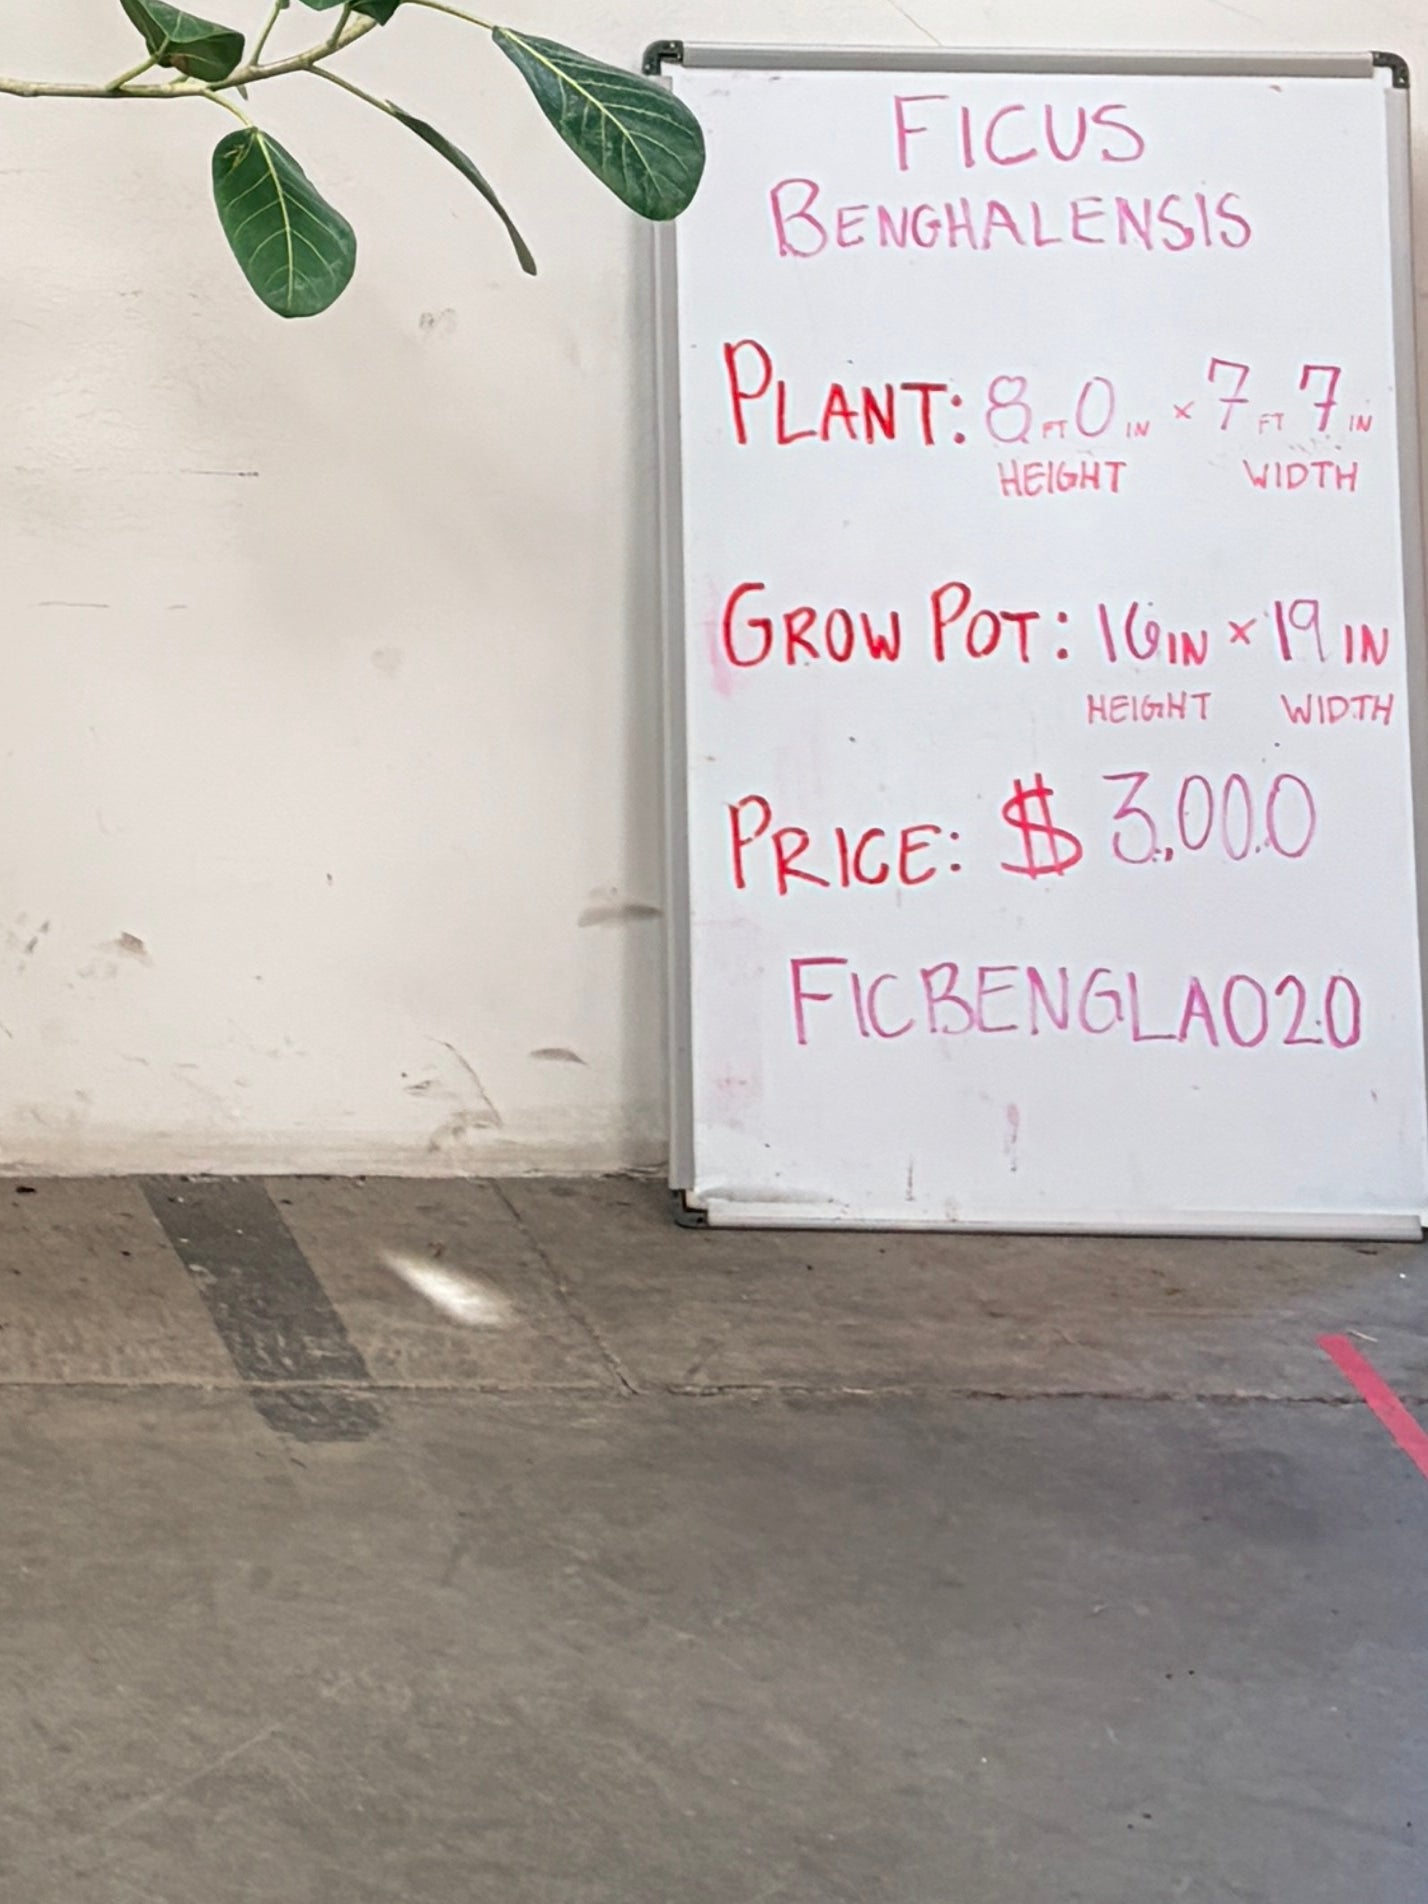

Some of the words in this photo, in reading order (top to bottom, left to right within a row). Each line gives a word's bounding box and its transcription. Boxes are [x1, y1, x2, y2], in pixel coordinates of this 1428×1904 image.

[893, 95, 1146, 173] FICUS
[767, 177, 1253, 259] BENGHALENSIS
[721, 338, 967, 448] PLANT:
[983, 375, 1032, 445] 8
[1206, 356, 1250, 432] 7
[1297, 363, 1342, 433] 7
[998, 459, 1126, 499] HEIGHT
[1242, 459, 1360, 493] WIDTH
[718, 580, 903, 670] GROW
[1085, 690, 1210, 725] HEIGHT
[1279, 692, 1396, 727] WIDTH
[727, 794, 962, 898] PRICE:
